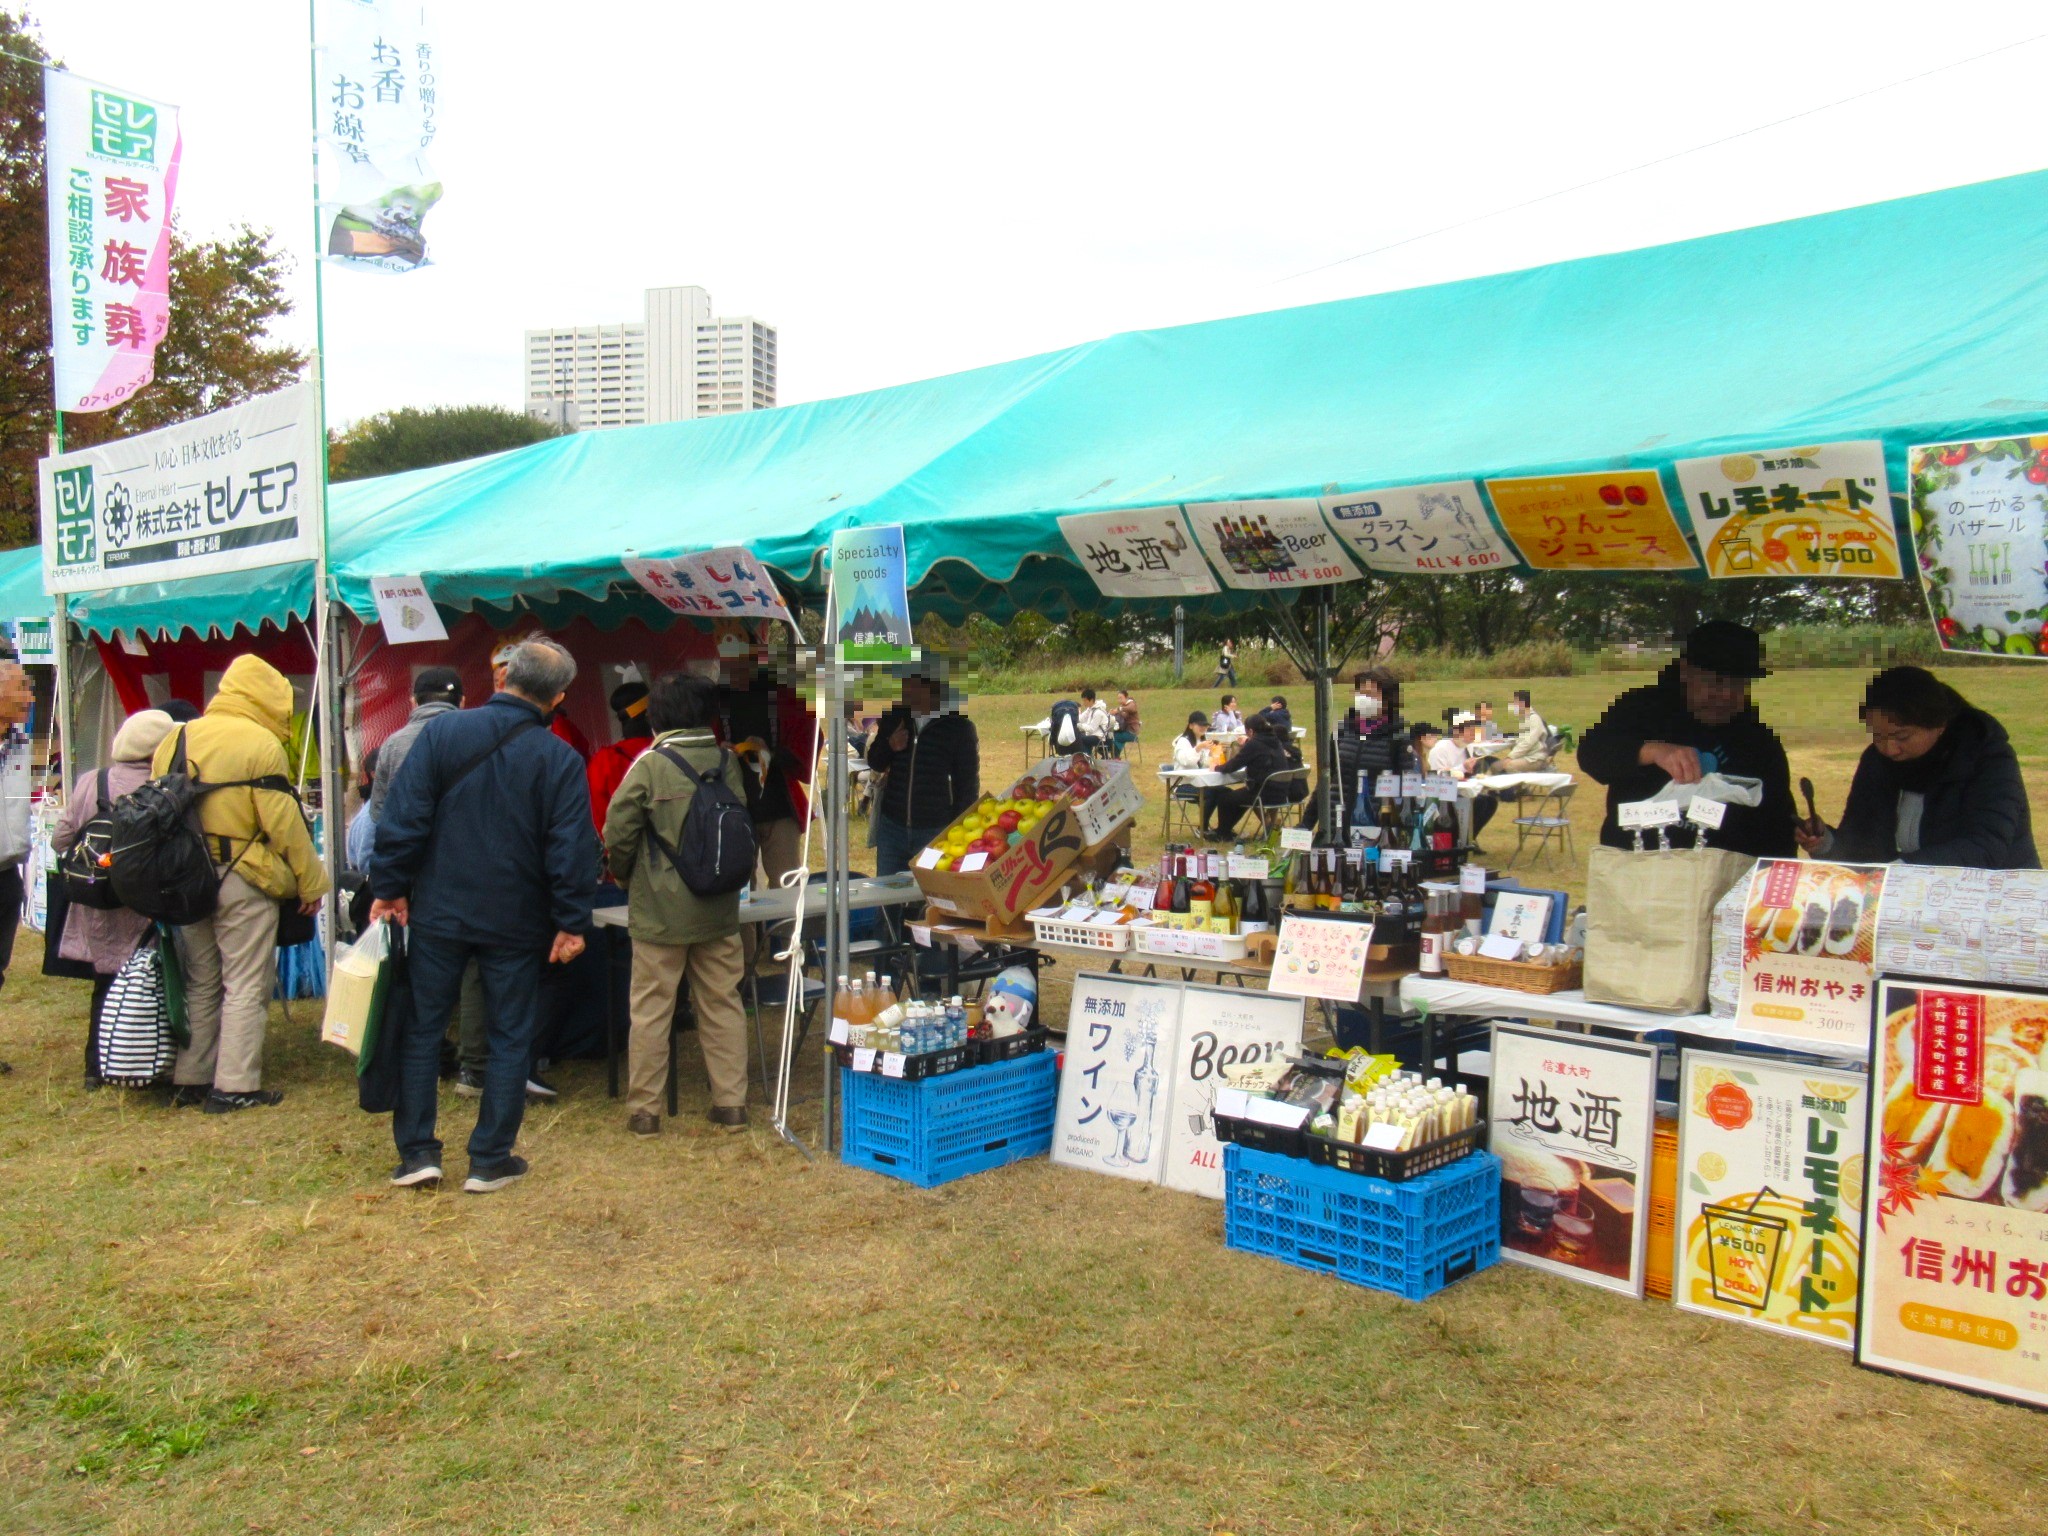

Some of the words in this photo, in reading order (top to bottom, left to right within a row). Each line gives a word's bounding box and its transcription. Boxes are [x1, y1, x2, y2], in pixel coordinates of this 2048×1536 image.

[371, 36, 405, 105] お香
[416, 42, 437, 148] 香りの贈りもの
[68, 167, 95, 347] ご相談承ります
[101, 176, 150, 350] 家族葬
[1762, 457, 1804, 472] 無添加
[135, 485, 157, 504] Eternal
[158, 482, 177, 498] Heart
[1700, 477, 1877, 520] レモネード
[1340, 504, 1376, 518] 無添加
[1948, 495, 2026, 516] のーかる
[1362, 519, 1414, 535] グラス
[1543, 510, 1635, 535] りんご
[1948, 517, 2026, 537] バザール
[1283, 533, 1327, 553] Beer
[1354, 534, 1439, 553] ワイン
[1538, 536, 1667, 557] ジュース
[1797, 532, 1822, 542] HOT
[1827, 533, 1839, 541] or
[1844, 531, 1877, 542] COLD
[837, 545, 899, 562] Specialty
[1085, 536, 1171, 574] 地酒
[1416, 557, 1446, 569] ALL
[1806, 547, 1875, 564] ¥500
[646, 560, 756, 589] たましん
[853, 566, 887, 582] goods
[1268, 567, 1295, 583] ALL
[853, 631, 899, 645] 信濃大町
[1753, 971, 1866, 1003] 信州おやき
[1084, 996, 1126, 1018] 無添加
[1816, 1017, 1857, 1032] 300円
[1932, 997, 1947, 1091] 長野県大町市産
[1955, 1005, 1969, 1086] 信濃の郷土食
[1190, 1031, 1285, 1081] Beer
[1078, 1022, 1113, 1125] ワイン
[1541, 1058, 1592, 1080] 信濃大町
[1511, 1076, 1623, 1149] 地酒
[1067, 1133, 1094, 1146] produced
[1093, 1138, 1101, 1146] in
[1066, 1145, 1095, 1158] NAGANO
[1190, 1149, 1217, 1170] ALL
[1799, 1115, 1840, 1315] レモネード
[1718, 1220, 1766, 1239] LEMONADE
[1719, 1234, 1767, 1256] ¥500
[1728, 1255, 1755, 1270] HOT
[1900, 1235, 2048, 1303] 信州お
[1723, 1278, 1758, 1295] COLD
[1906, 1308, 2009, 1344] 天然酵母使用
